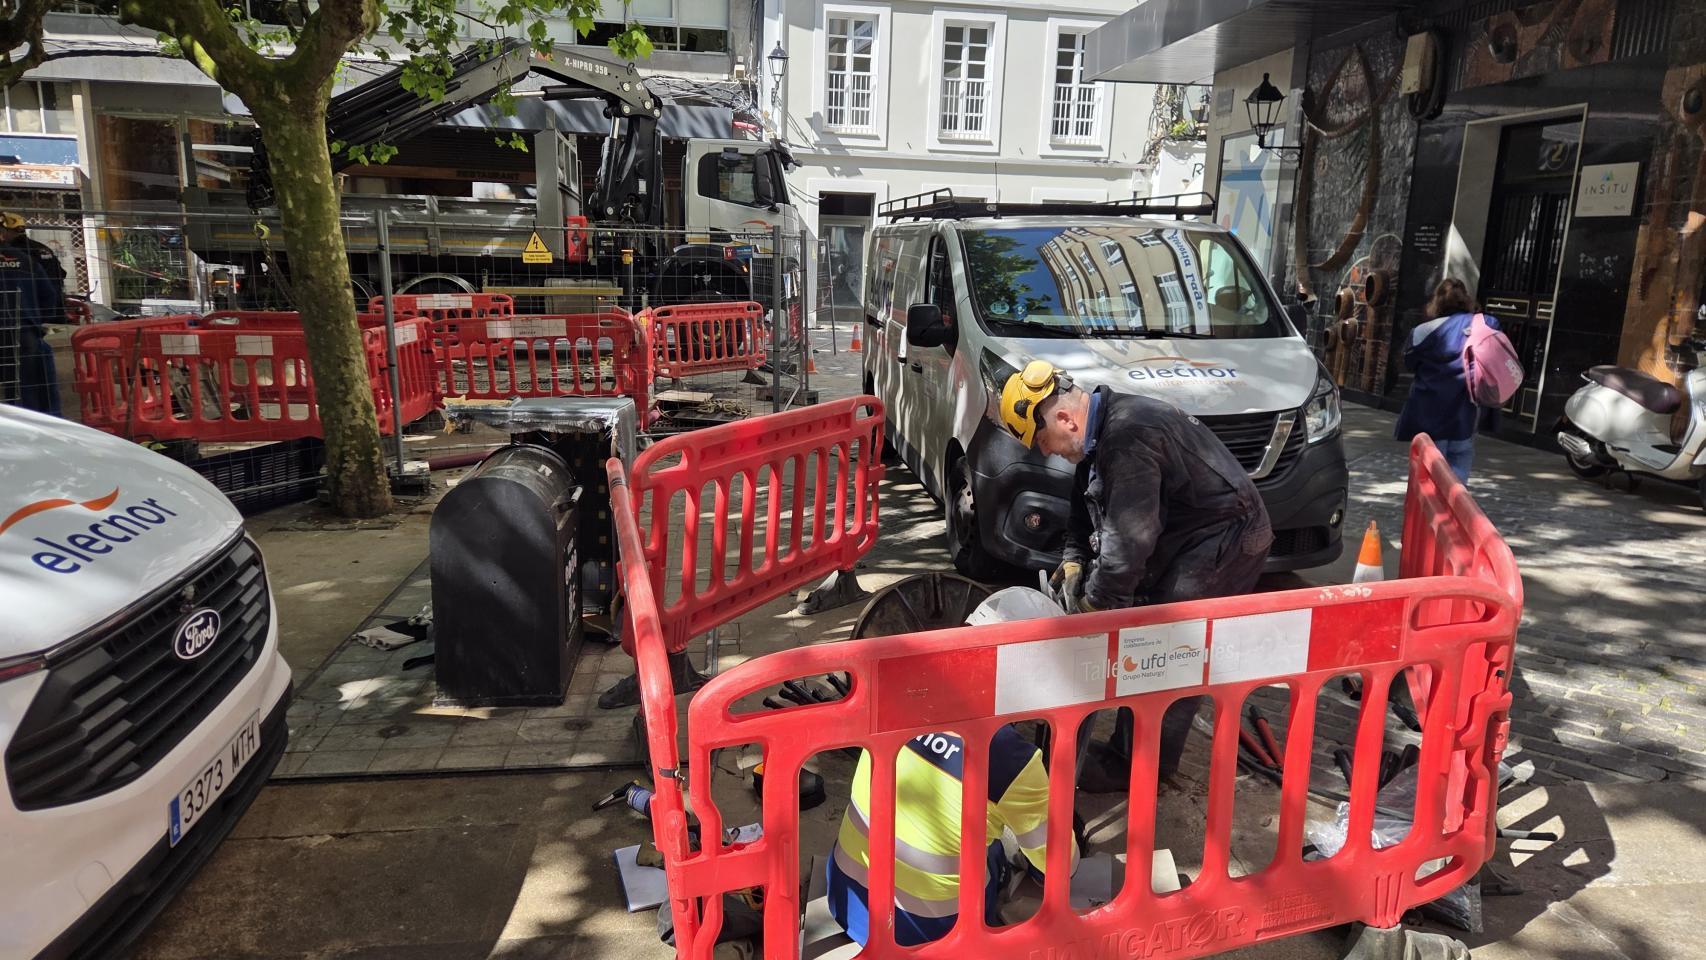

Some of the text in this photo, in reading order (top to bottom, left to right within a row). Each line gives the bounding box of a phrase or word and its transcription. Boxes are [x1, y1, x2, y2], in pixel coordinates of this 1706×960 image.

[564, 57, 593, 72] X-HIPRO
[1584, 183, 1629, 195] INSITU
[1128, 366, 1238, 380] elecnor
[31, 497, 178, 574] elecnor
[184, 615, 215, 656] Ford
[1141, 653, 1167, 670] ufd
[1169, 650, 1201, 661] elecnor
[1122, 670, 1165, 681] Grupo Naturgy
[184, 721, 255, 823] 3373 MTH
